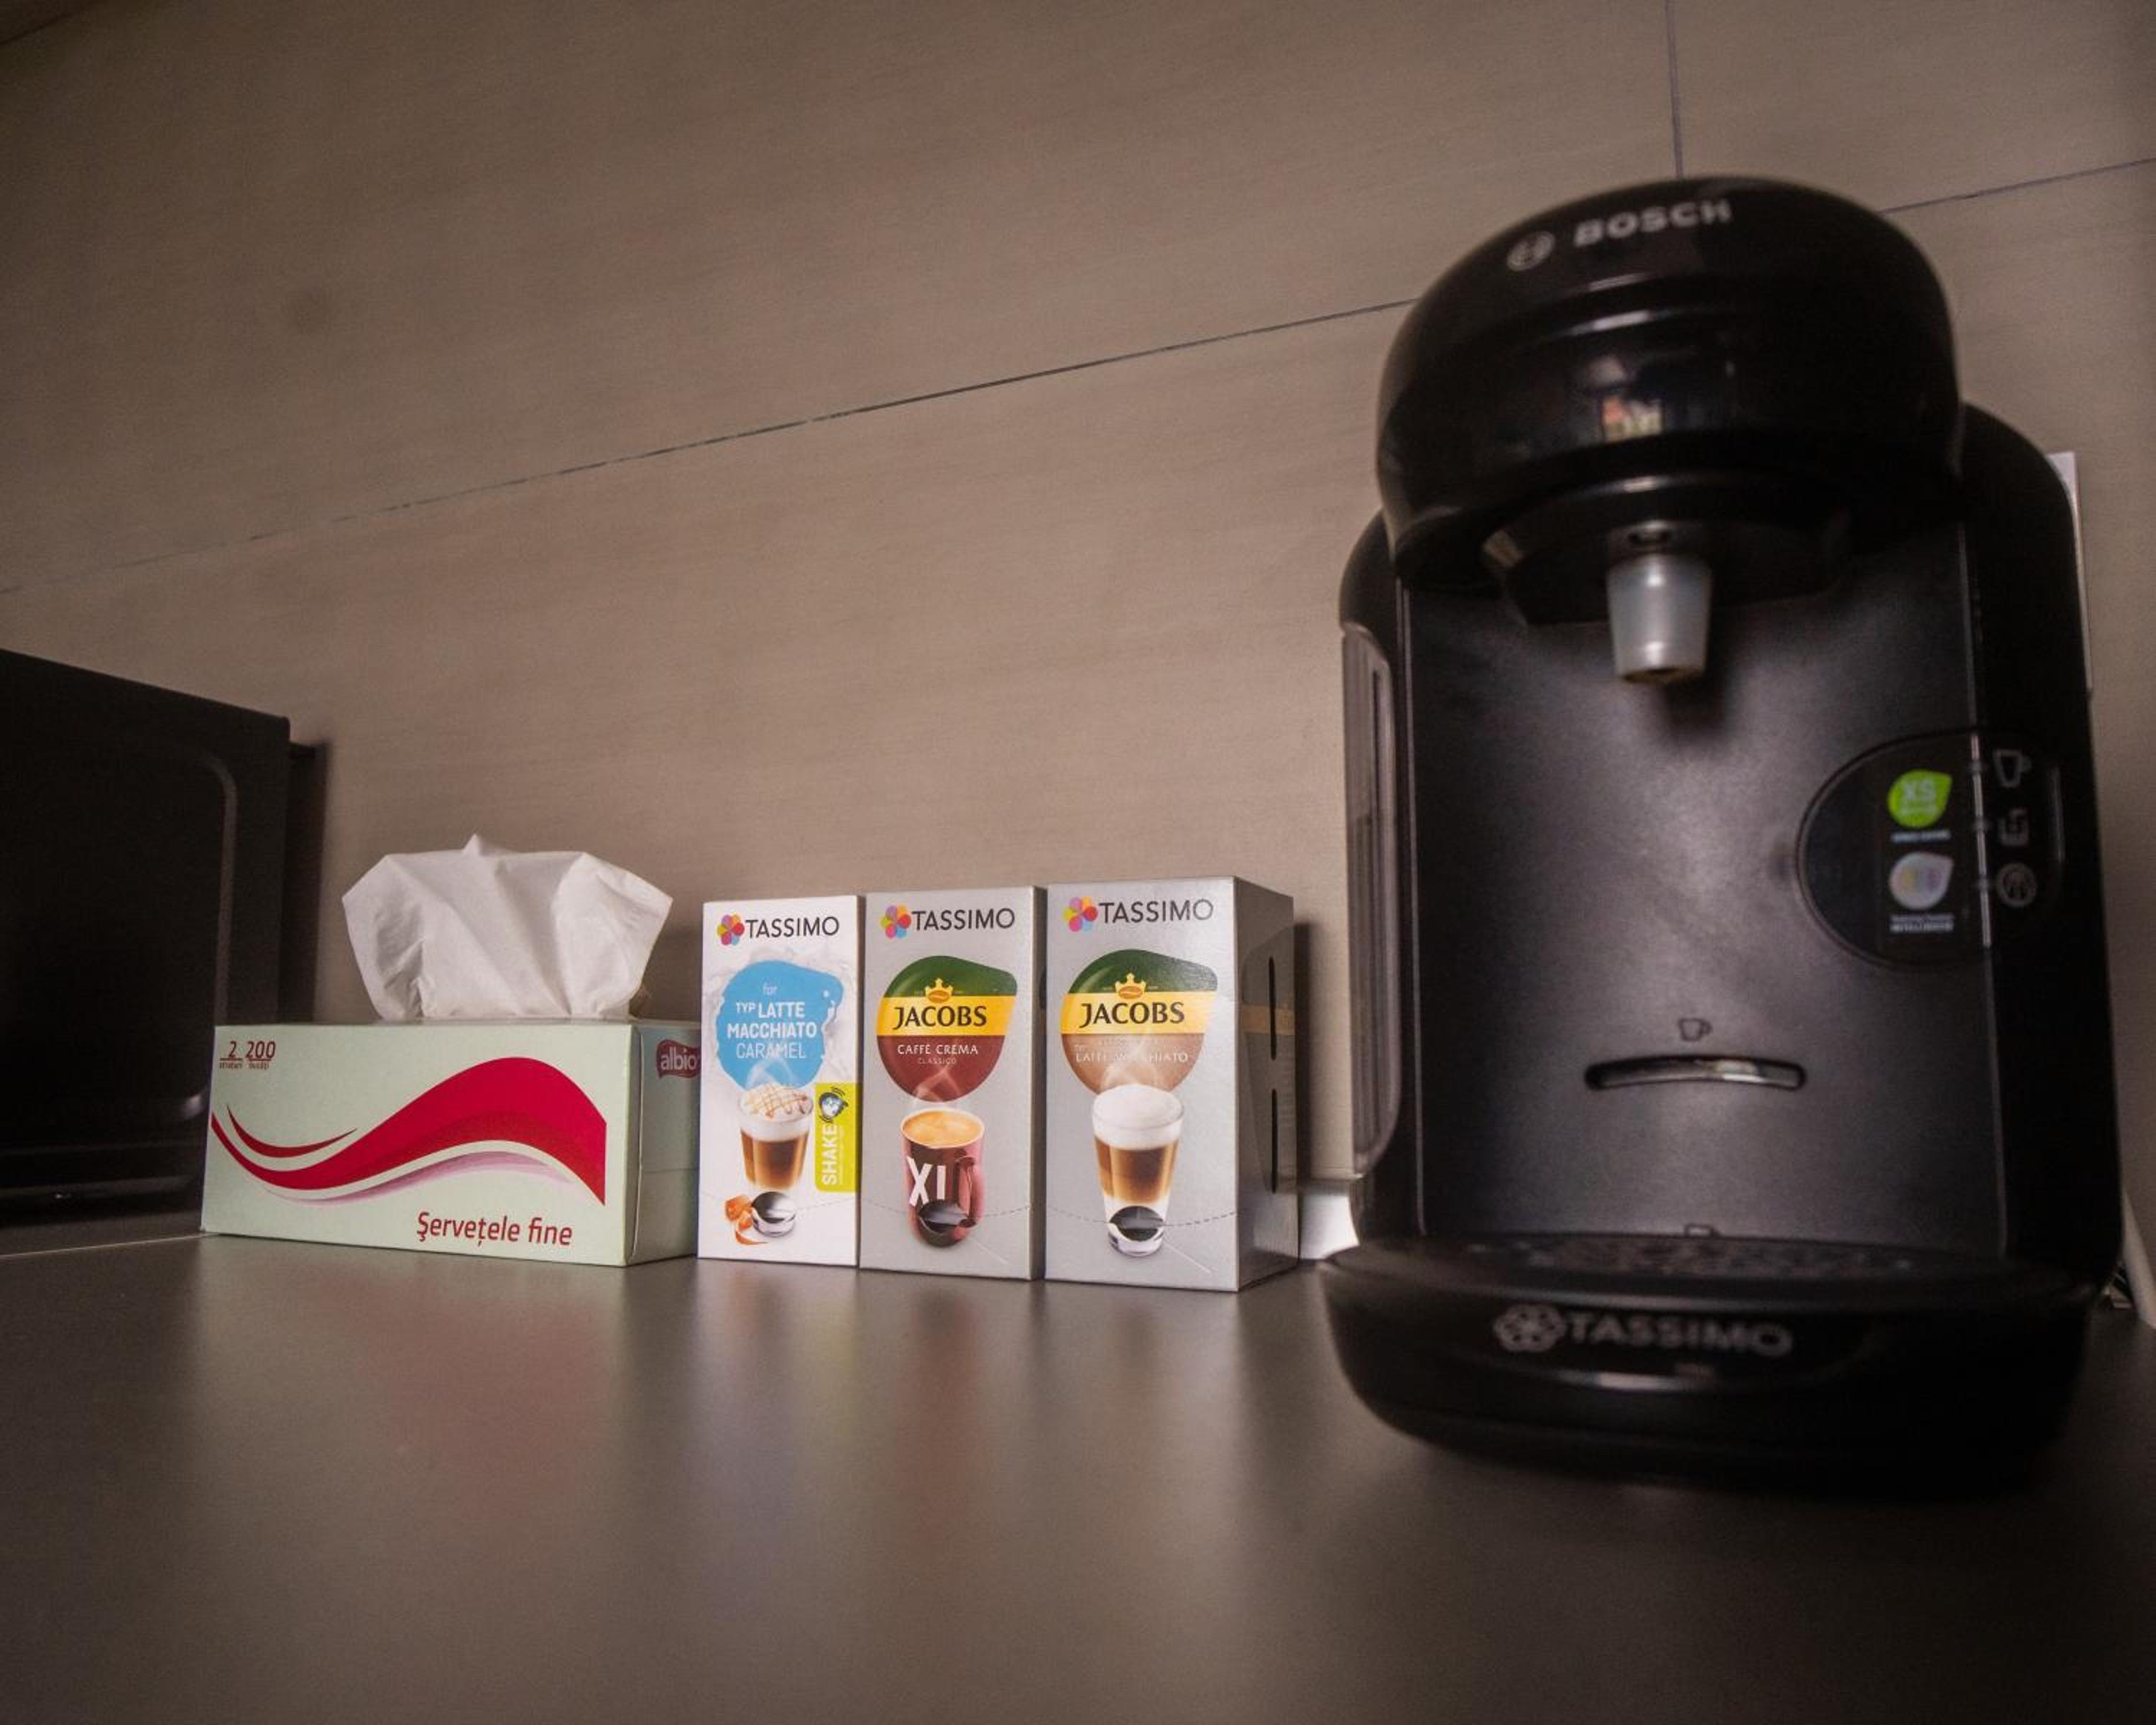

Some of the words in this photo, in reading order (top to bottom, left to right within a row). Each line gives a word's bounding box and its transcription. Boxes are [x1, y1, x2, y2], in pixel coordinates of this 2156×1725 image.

[1574, 198, 1732, 247] BOSCH
[911, 907, 1015, 932] TASSIMO
[1098, 898, 1214, 924] TASSIMO
[745, 916, 840, 939] TASSIMO
[735, 1002, 756, 1013] TYP
[757, 1001, 806, 1018] LATTE
[893, 1006, 987, 1031] JACOBS
[1079, 1001, 1185, 1029] JACOBS
[727, 1021, 818, 1039] MACCHIATO
[228, 1040, 237, 1059] 2
[245, 1040, 277, 1059] 200
[735, 1041, 807, 1059] CARAMEL
[936, 1044, 979, 1055] CREMA
[821, 1123, 837, 1185] SHAKE
[528, 1217, 573, 1246] fine
[1565, 1311, 1793, 1357] TASSIMO
